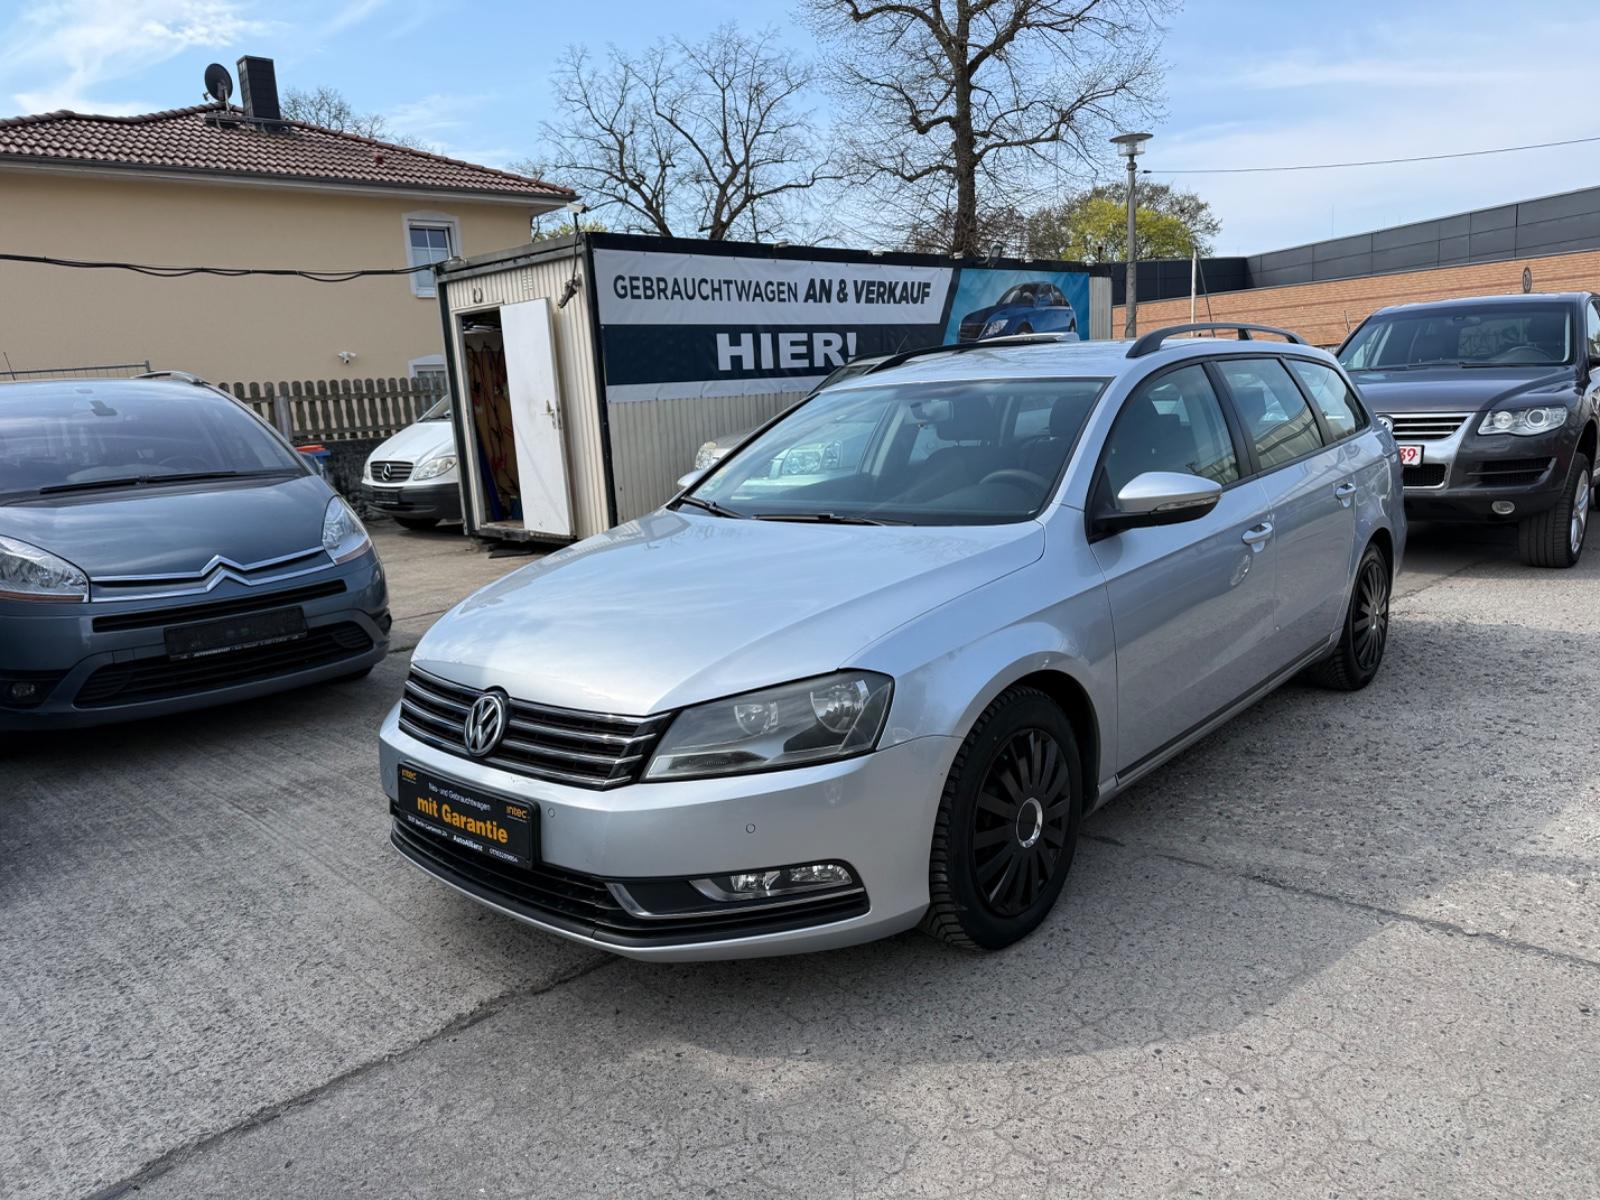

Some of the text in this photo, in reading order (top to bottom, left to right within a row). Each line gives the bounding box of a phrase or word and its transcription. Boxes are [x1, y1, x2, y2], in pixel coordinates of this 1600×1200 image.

[613, 275, 931, 305] GEBRAUCHTWAGEN AN & VERKAUF
[716, 332, 857, 371] HIER!
[417, 795, 439, 818] mit
[441, 803, 509, 844] Garantie
